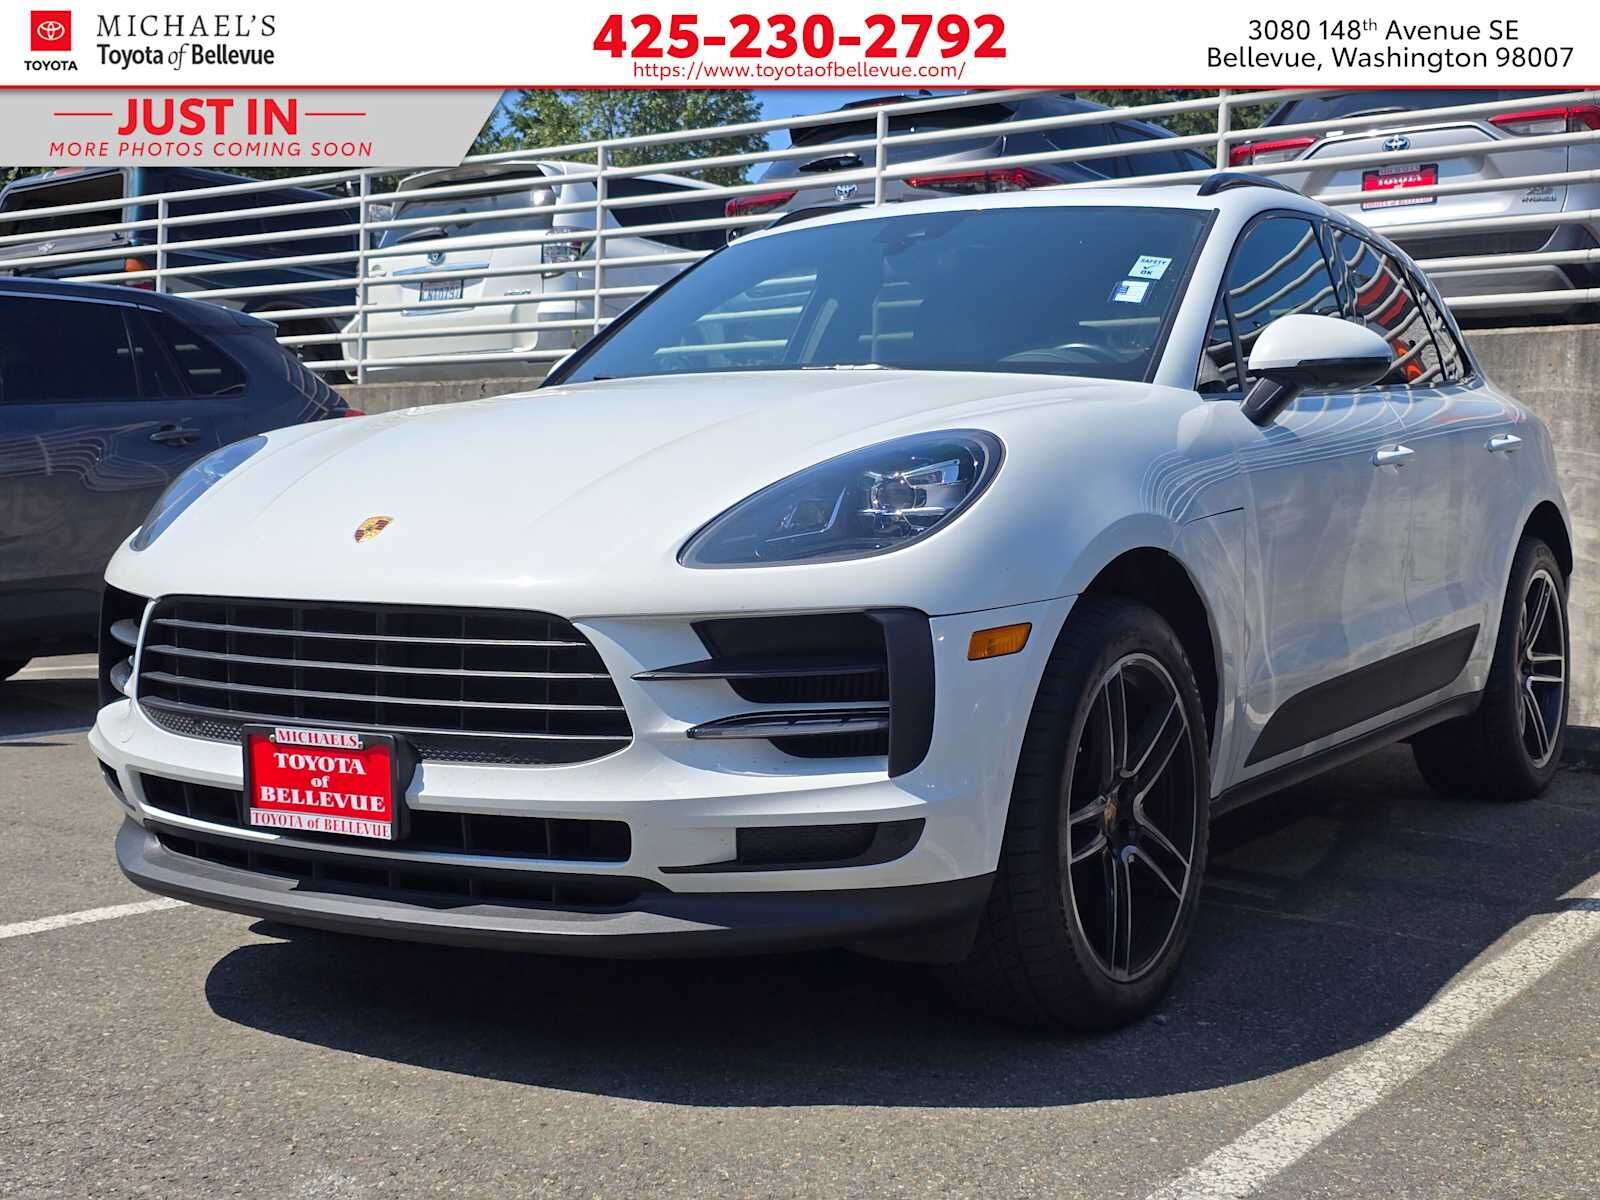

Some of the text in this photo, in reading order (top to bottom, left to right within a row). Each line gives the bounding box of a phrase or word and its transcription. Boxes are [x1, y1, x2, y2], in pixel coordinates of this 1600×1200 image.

[273, 752, 367, 775] TOYOTA
[310, 776, 330, 788] of
[260, 786, 386, 812] BELLEVUE
[252, 811, 391, 838] TOYOTA of BELLEVUE
